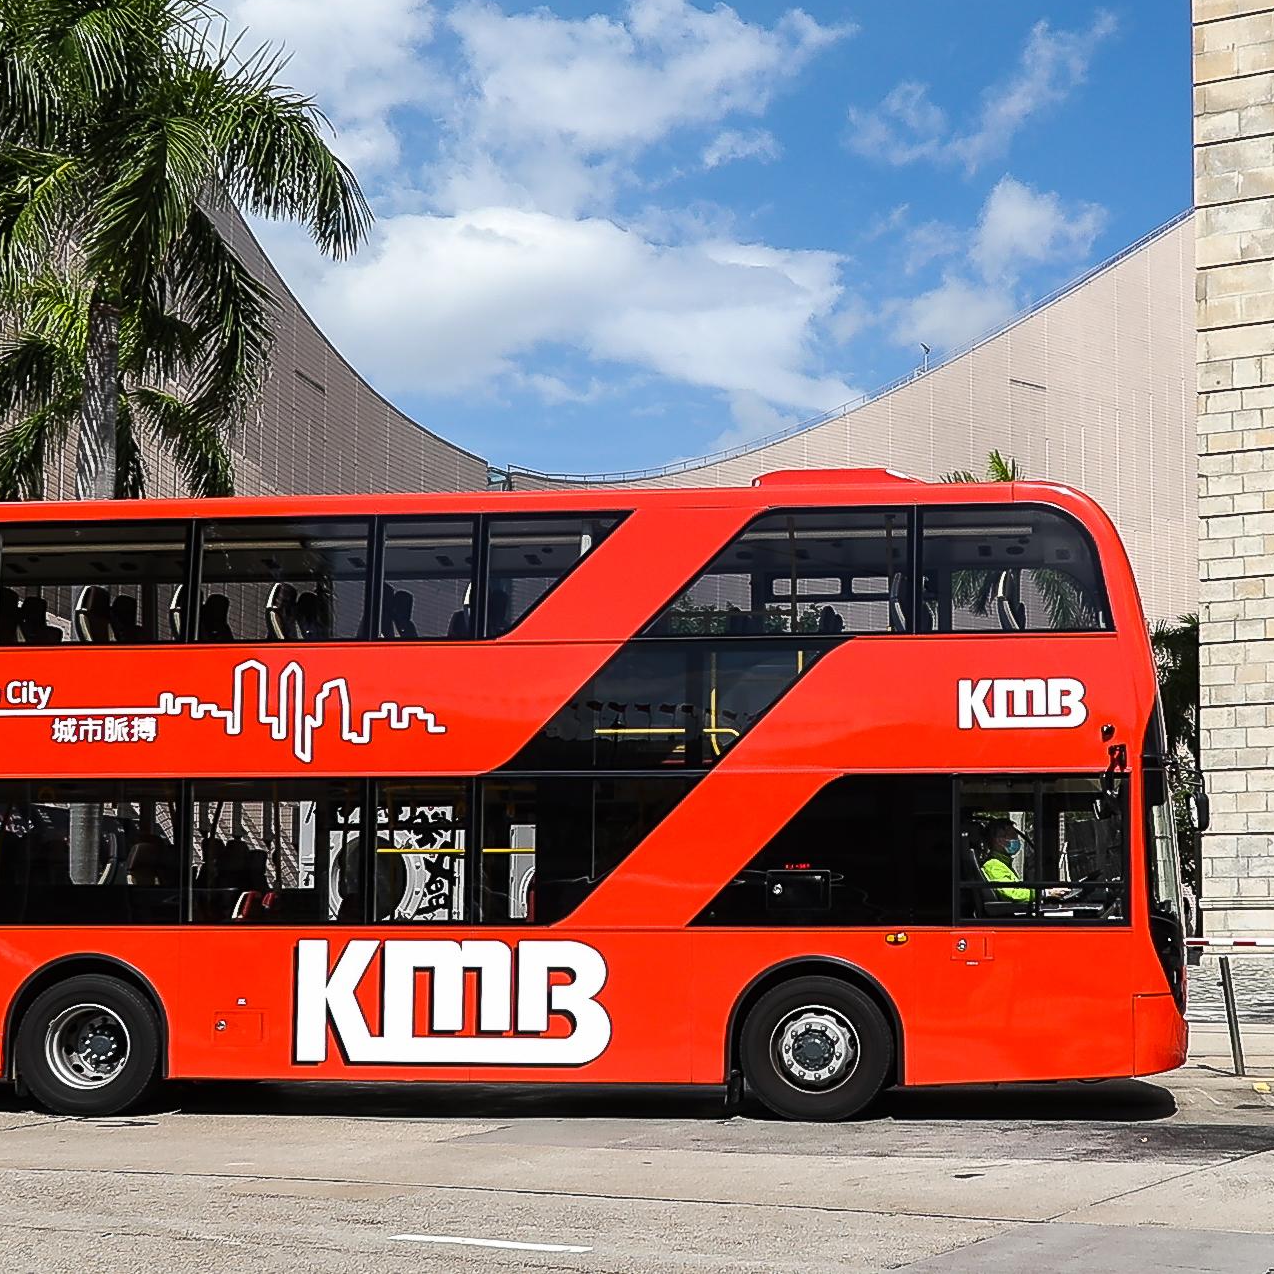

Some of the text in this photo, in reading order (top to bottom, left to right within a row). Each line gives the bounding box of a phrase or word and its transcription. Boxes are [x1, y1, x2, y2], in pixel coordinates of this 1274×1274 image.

[6, 680, 53, 710] City
[51, 717, 157, 742] 城市脈搏
